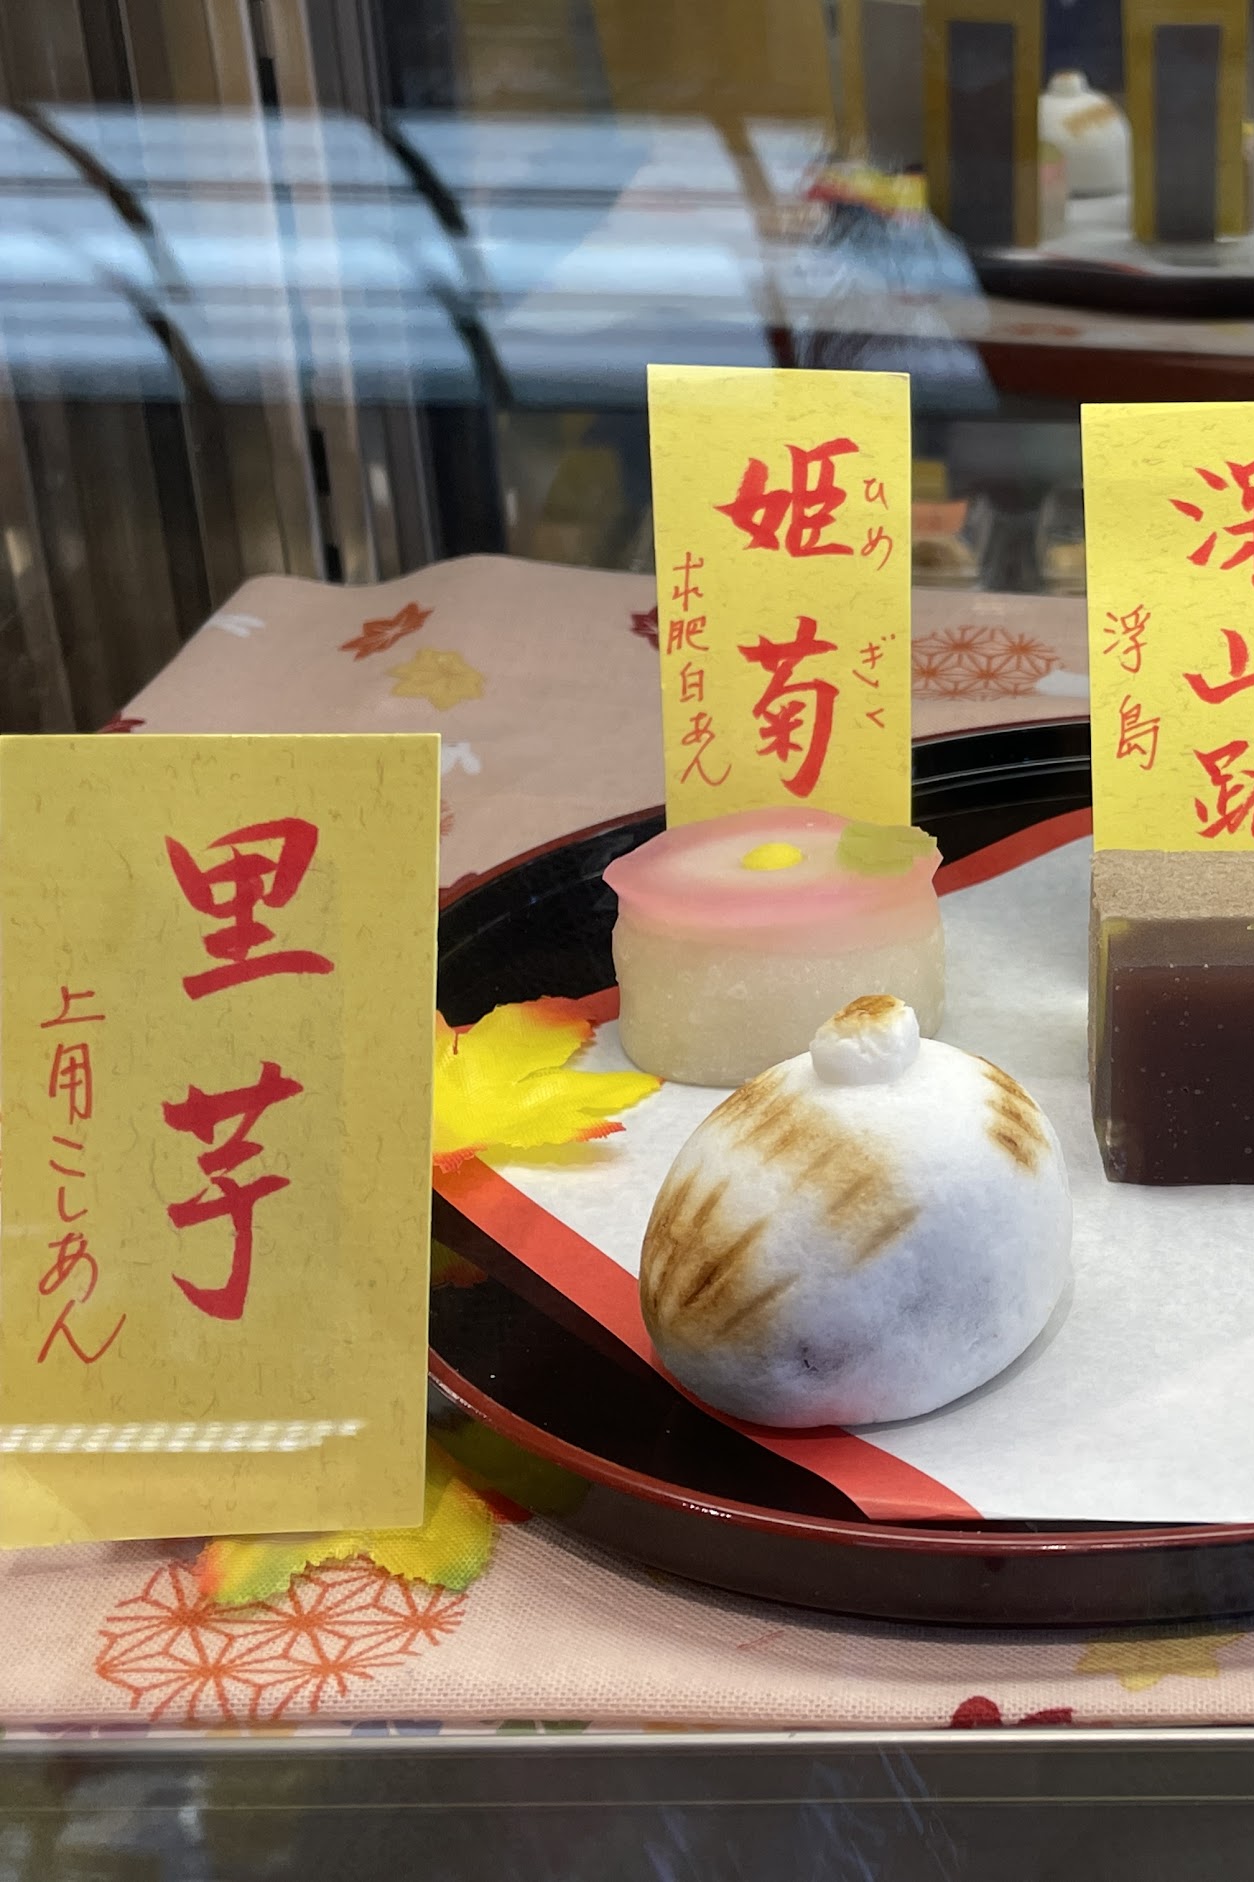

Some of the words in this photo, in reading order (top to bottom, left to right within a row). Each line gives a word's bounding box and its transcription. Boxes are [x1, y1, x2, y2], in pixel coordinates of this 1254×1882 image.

[711, 436, 861, 800] 姫菊
[851, 476, 896, 730] ひめぎく
[1103, 604, 1162, 771] 浮島
[36, 985, 128, 1366] 上用こしあん
[161, 816, 336, 1322] 里芋
